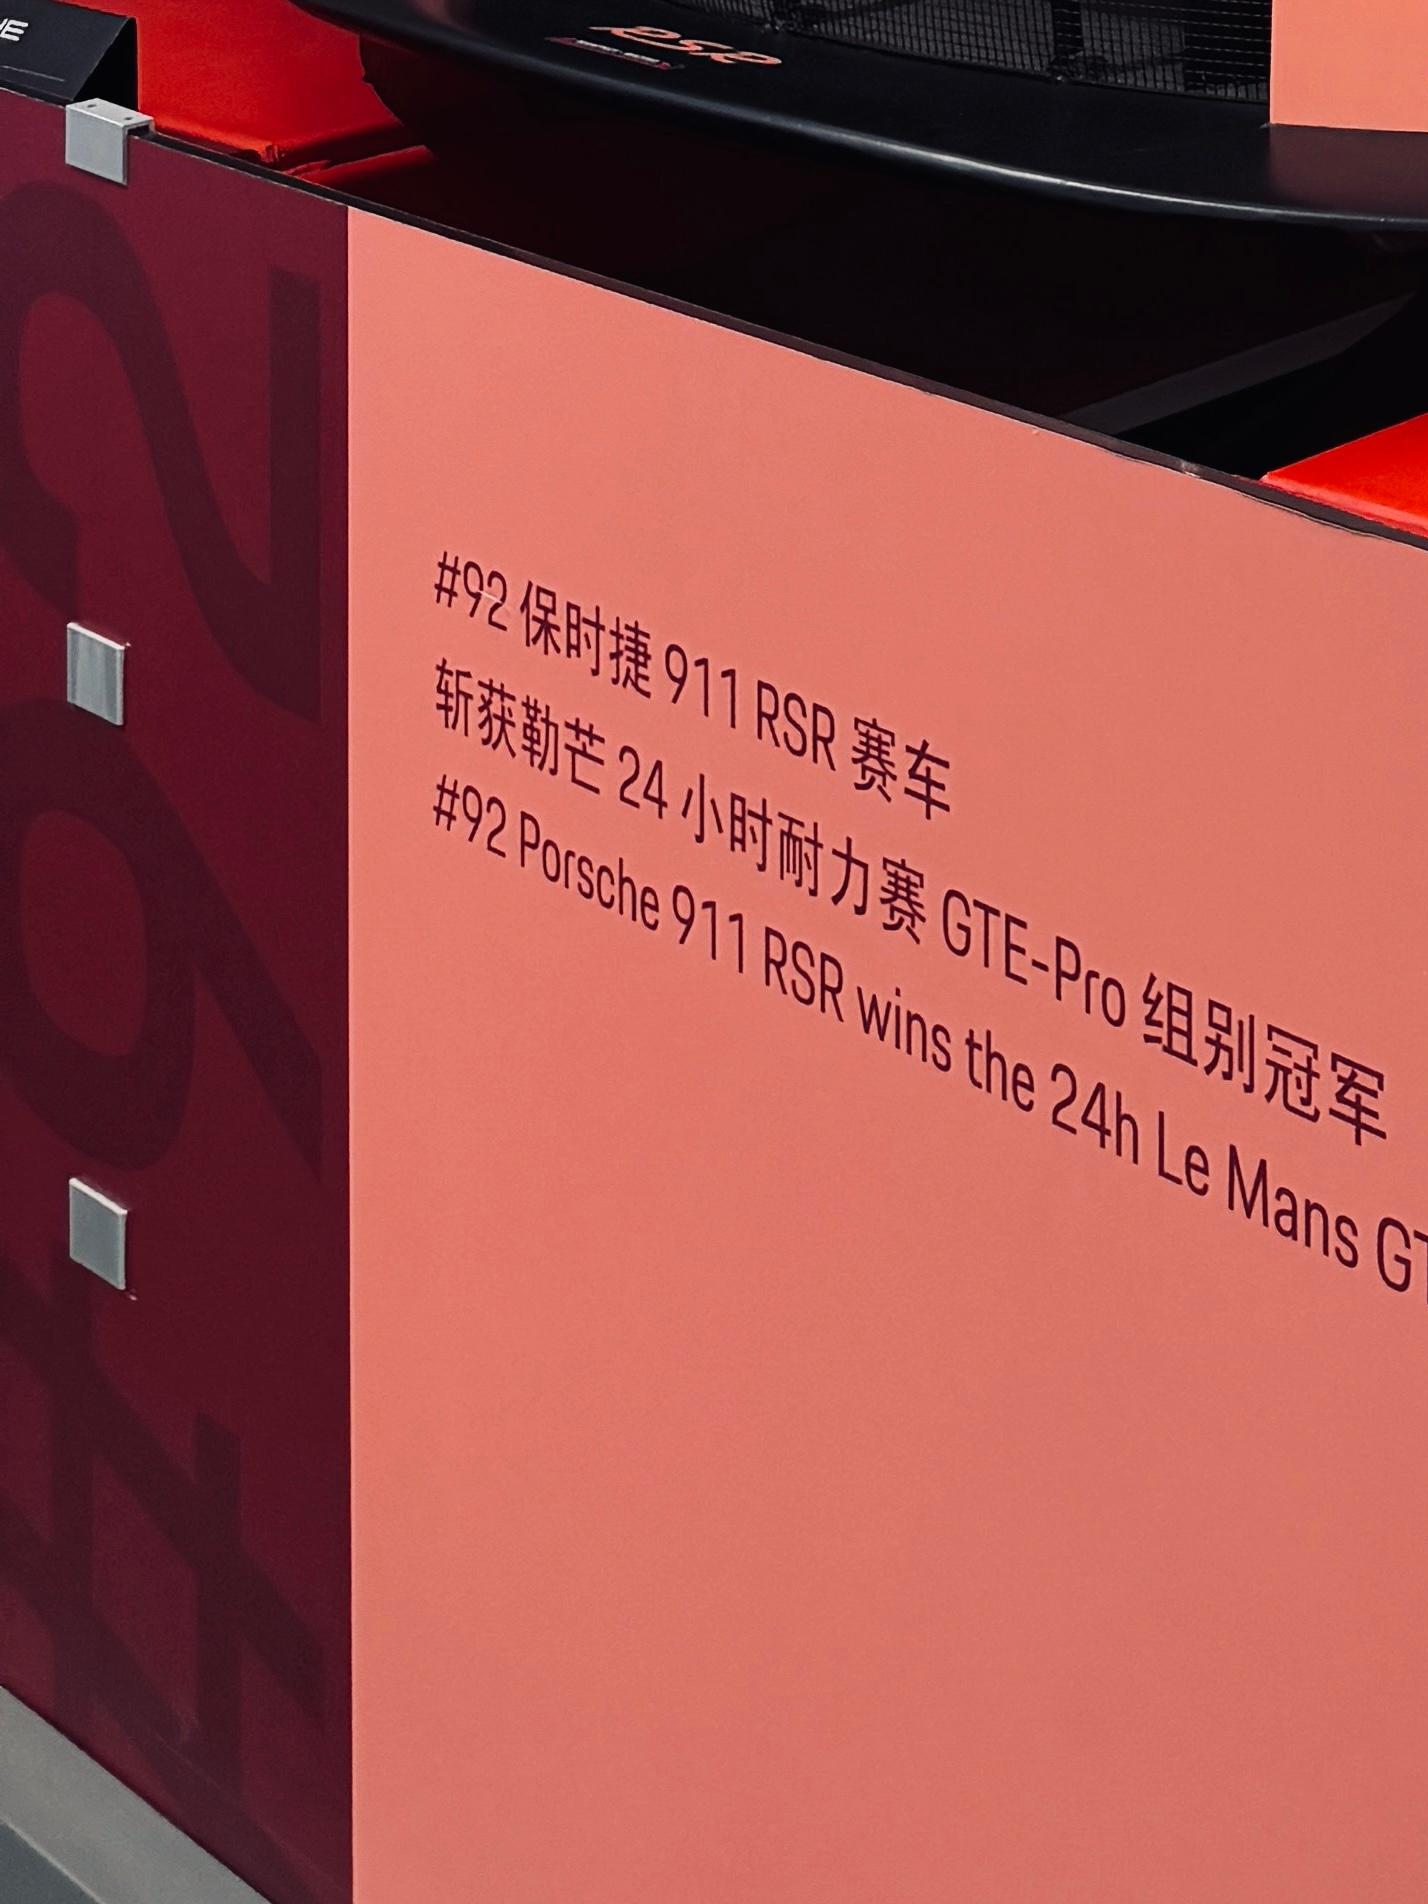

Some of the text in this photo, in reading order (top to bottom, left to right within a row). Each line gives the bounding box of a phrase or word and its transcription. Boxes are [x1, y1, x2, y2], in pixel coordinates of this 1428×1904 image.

[433, 550, 951, 821] #92 保时捷 911 RSR 赛车
[434, 656, 1388, 1147] 斩获勒芒 24 小时耐力赛 GTE-Pro 组别冠军
[433, 774, 507, 859] #92
[520, 810, 660, 932] Porsche
[673, 884, 744, 974] 911
[764, 925, 845, 1023] RSR
[856, 985, 952, 1073] wins
[964, 1028, 1035, 1113] the
[1050, 1062, 1139, 1166] 24h
[1157, 1110, 1210, 1197] Le
[1228, 1143, 1359, 1269] Mans
